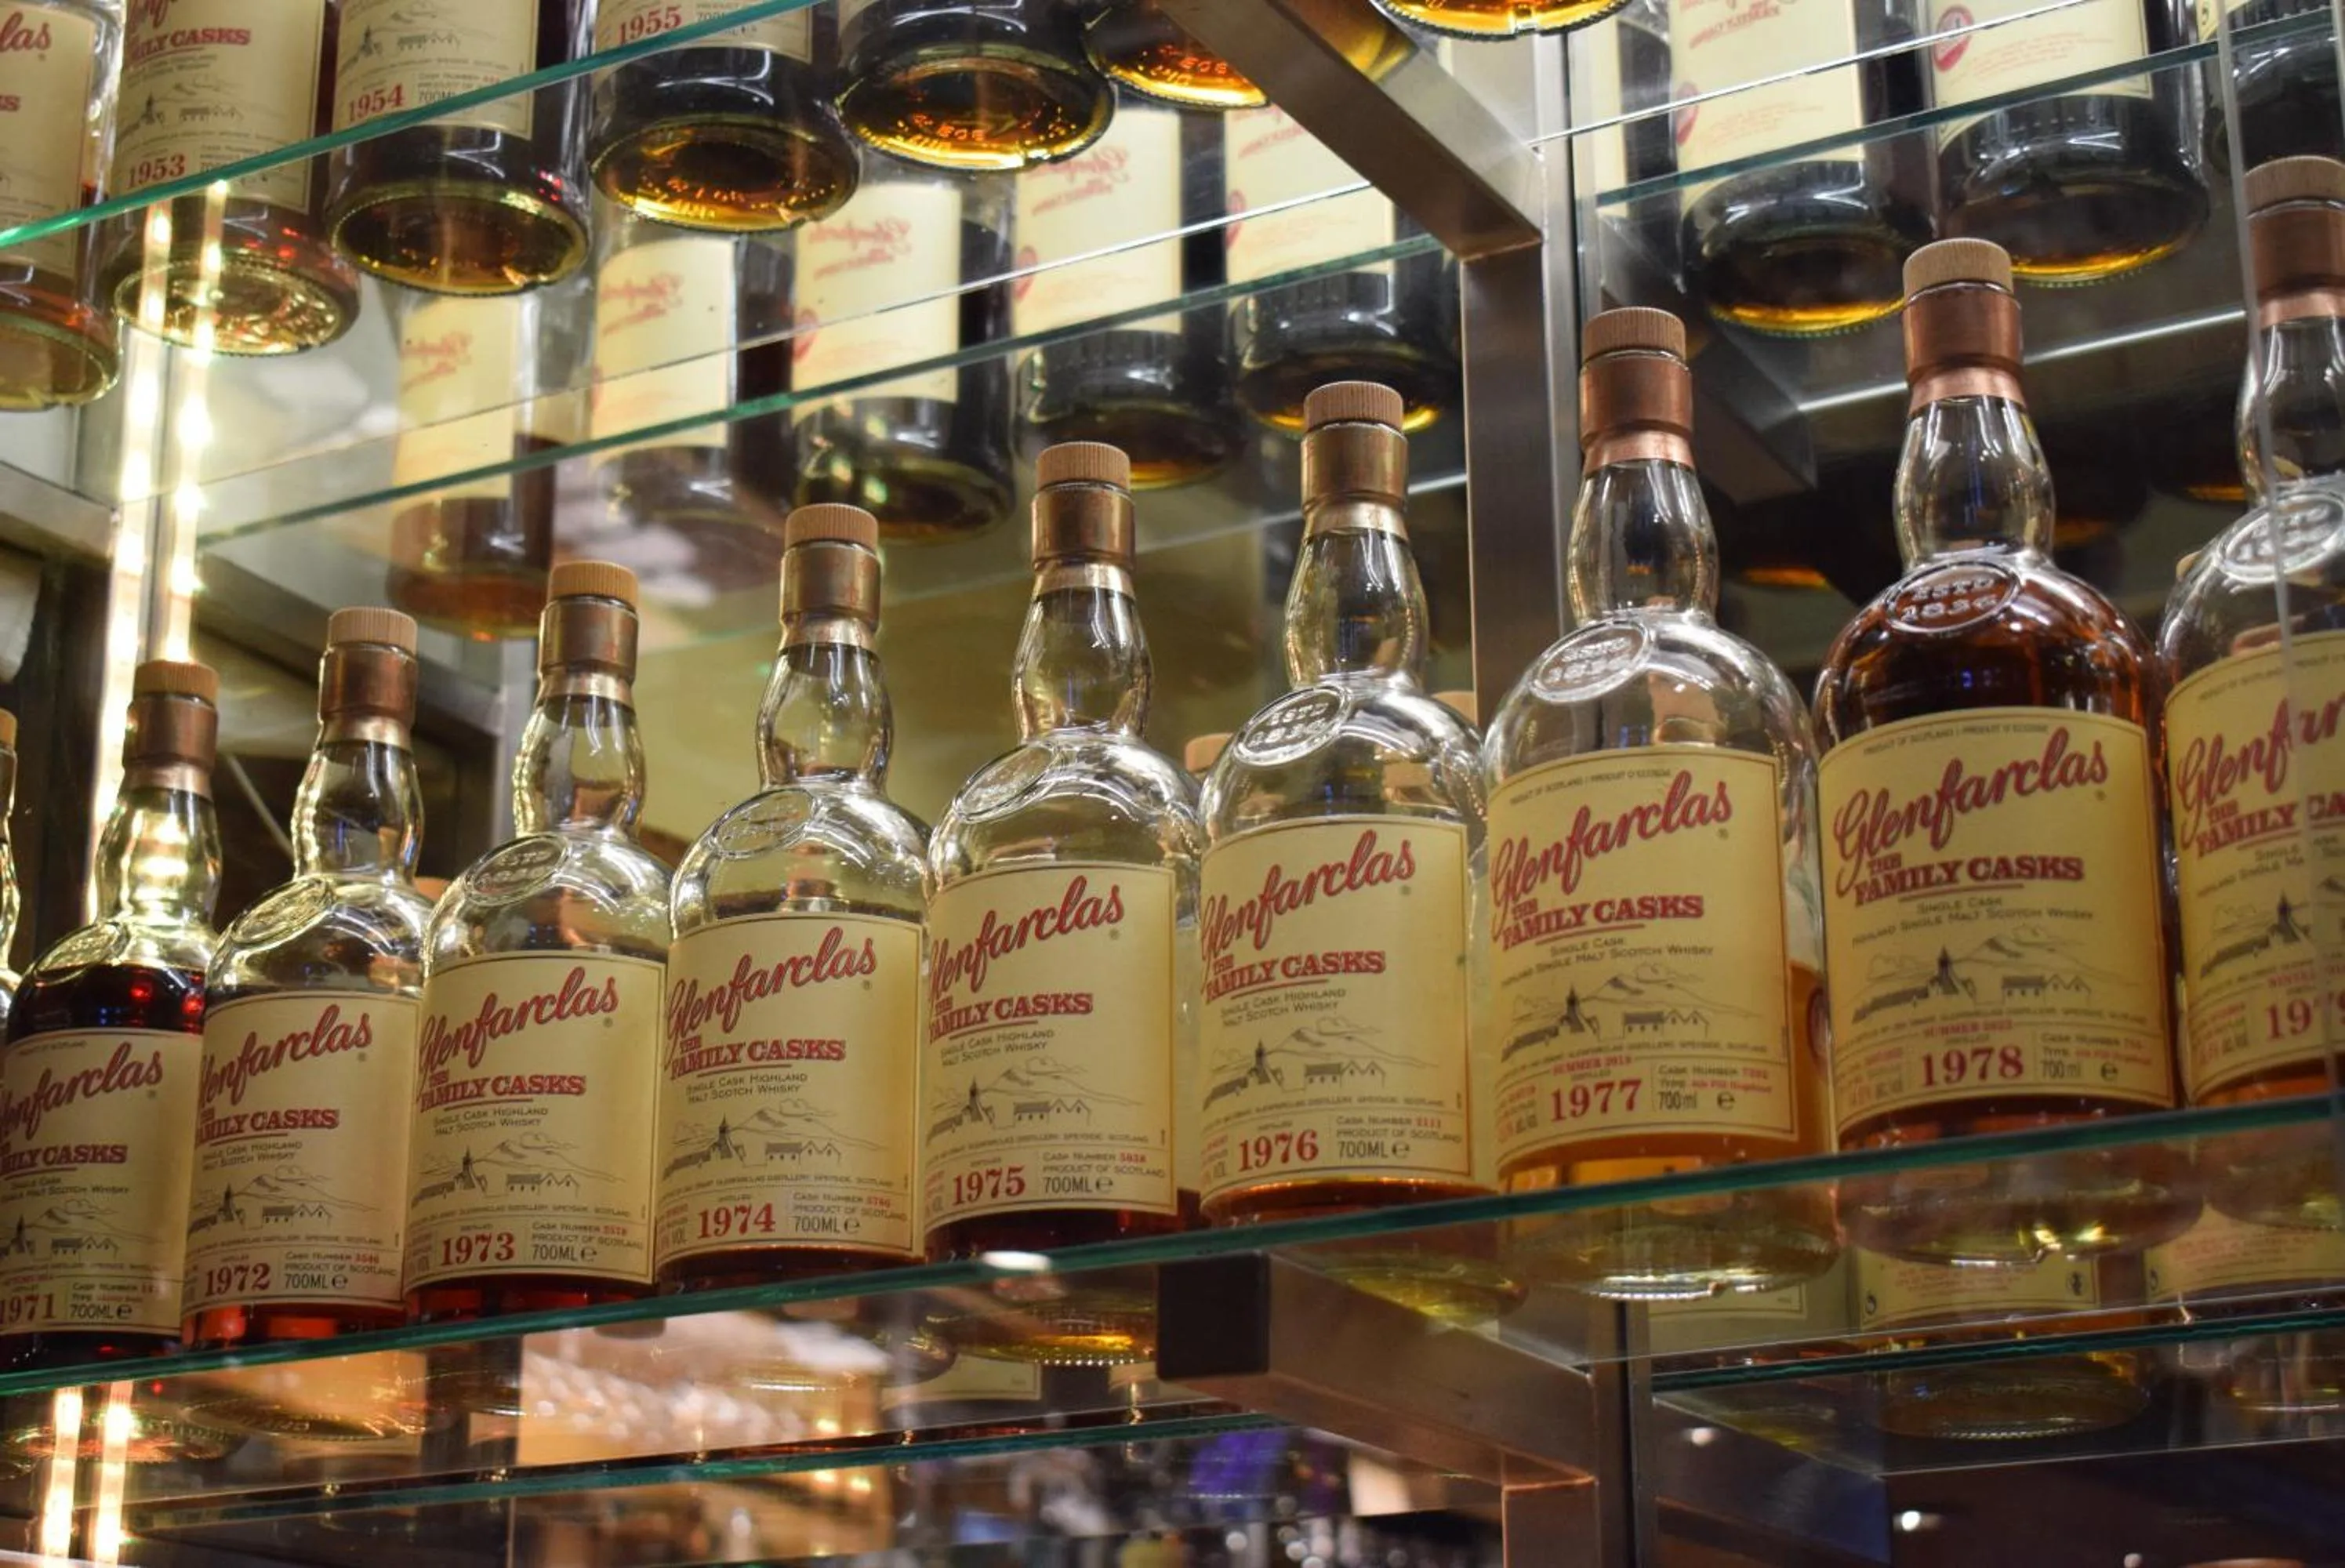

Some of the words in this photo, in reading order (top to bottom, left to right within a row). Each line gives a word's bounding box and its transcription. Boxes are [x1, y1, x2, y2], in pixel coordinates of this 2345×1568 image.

[170, 28, 251, 45] CASKS
[619, 5, 681, 45] 1955
[349, 83, 405, 122] 1954
[129, 154, 185, 188] 1953
[1833, 727, 2108, 898] Glenfarclas
[2197, 802, 2298, 858] FAMILY
[1490, 770, 1732, 943] Glenfarclas
[1854, 859, 1962, 908] FAMILY
[1966, 855, 2084, 881] CASKS
[1201, 829, 1416, 994] Glenfarclas
[1502, 903, 1590, 953] FAMILY
[1593, 895, 1704, 924] CASKS
[1205, 957, 1279, 1005] FAMILY
[1281, 950, 1386, 978] CASKS
[664, 926, 877, 1072] Glenfarclas
[418, 966, 619, 1101] Glenfarclas
[930, 1001, 993, 1045] FAMILY
[994, 993, 1093, 1020] CASKS
[671, 1041, 746, 1081] FAMILY
[747, 1040, 846, 1061] CASKS
[750, 1073, 808, 1083] HIGHLAND
[1921, 1044, 2024, 1088] 1978
[0, 1041, 163, 1142] enfarclas
[419, 1077, 491, 1113] FAMILY
[492, 1075, 586, 1097] CASKS
[1550, 1078, 1642, 1122] 1977
[196, 1112, 249, 1148] AMILY
[250, 1109, 339, 1130] CASKS
[0, 1148, 42, 1176] MILY
[43, 1145, 128, 1165] CASKS
[1238, 1129, 1320, 1173] 1976
[1338, 1140, 1389, 1159] 700ML
[952, 1165, 1026, 1207] 1975
[1042, 1176, 1093, 1193] 700ML
[698, 1203, 775, 1239] 1974
[793, 1216, 840, 1233] 700ML
[440, 1232, 516, 1267] 1973
[532, 1244, 578, 1262] 700ML
[205, 1262, 271, 1297] 1972
[289, 1273, 332, 1290] 700ML
[0, 1292, 57, 1326] 1971
[70, 1304, 114, 1321] 700ML
